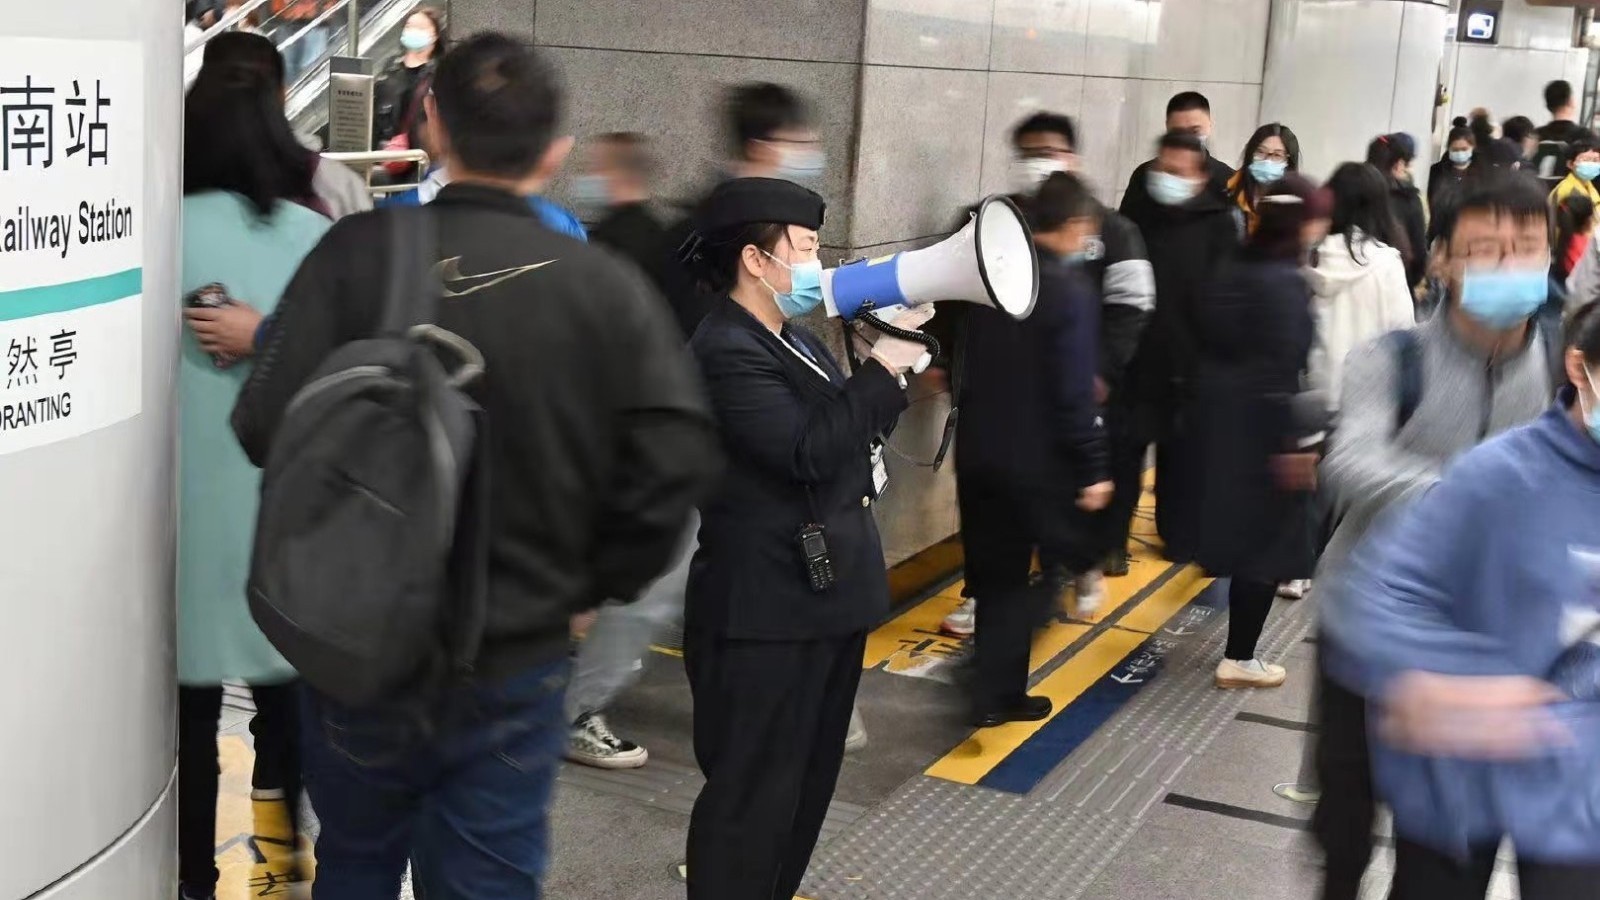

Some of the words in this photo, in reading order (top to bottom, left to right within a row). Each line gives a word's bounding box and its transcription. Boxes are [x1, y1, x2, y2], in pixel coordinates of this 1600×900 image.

[0, 75, 110, 170] 南站
[0, 206, 71, 258] ailway
[79, 198, 132, 244] Station
[7, 329, 77, 389] 然亭
[0, 392, 71, 431] RANTING
